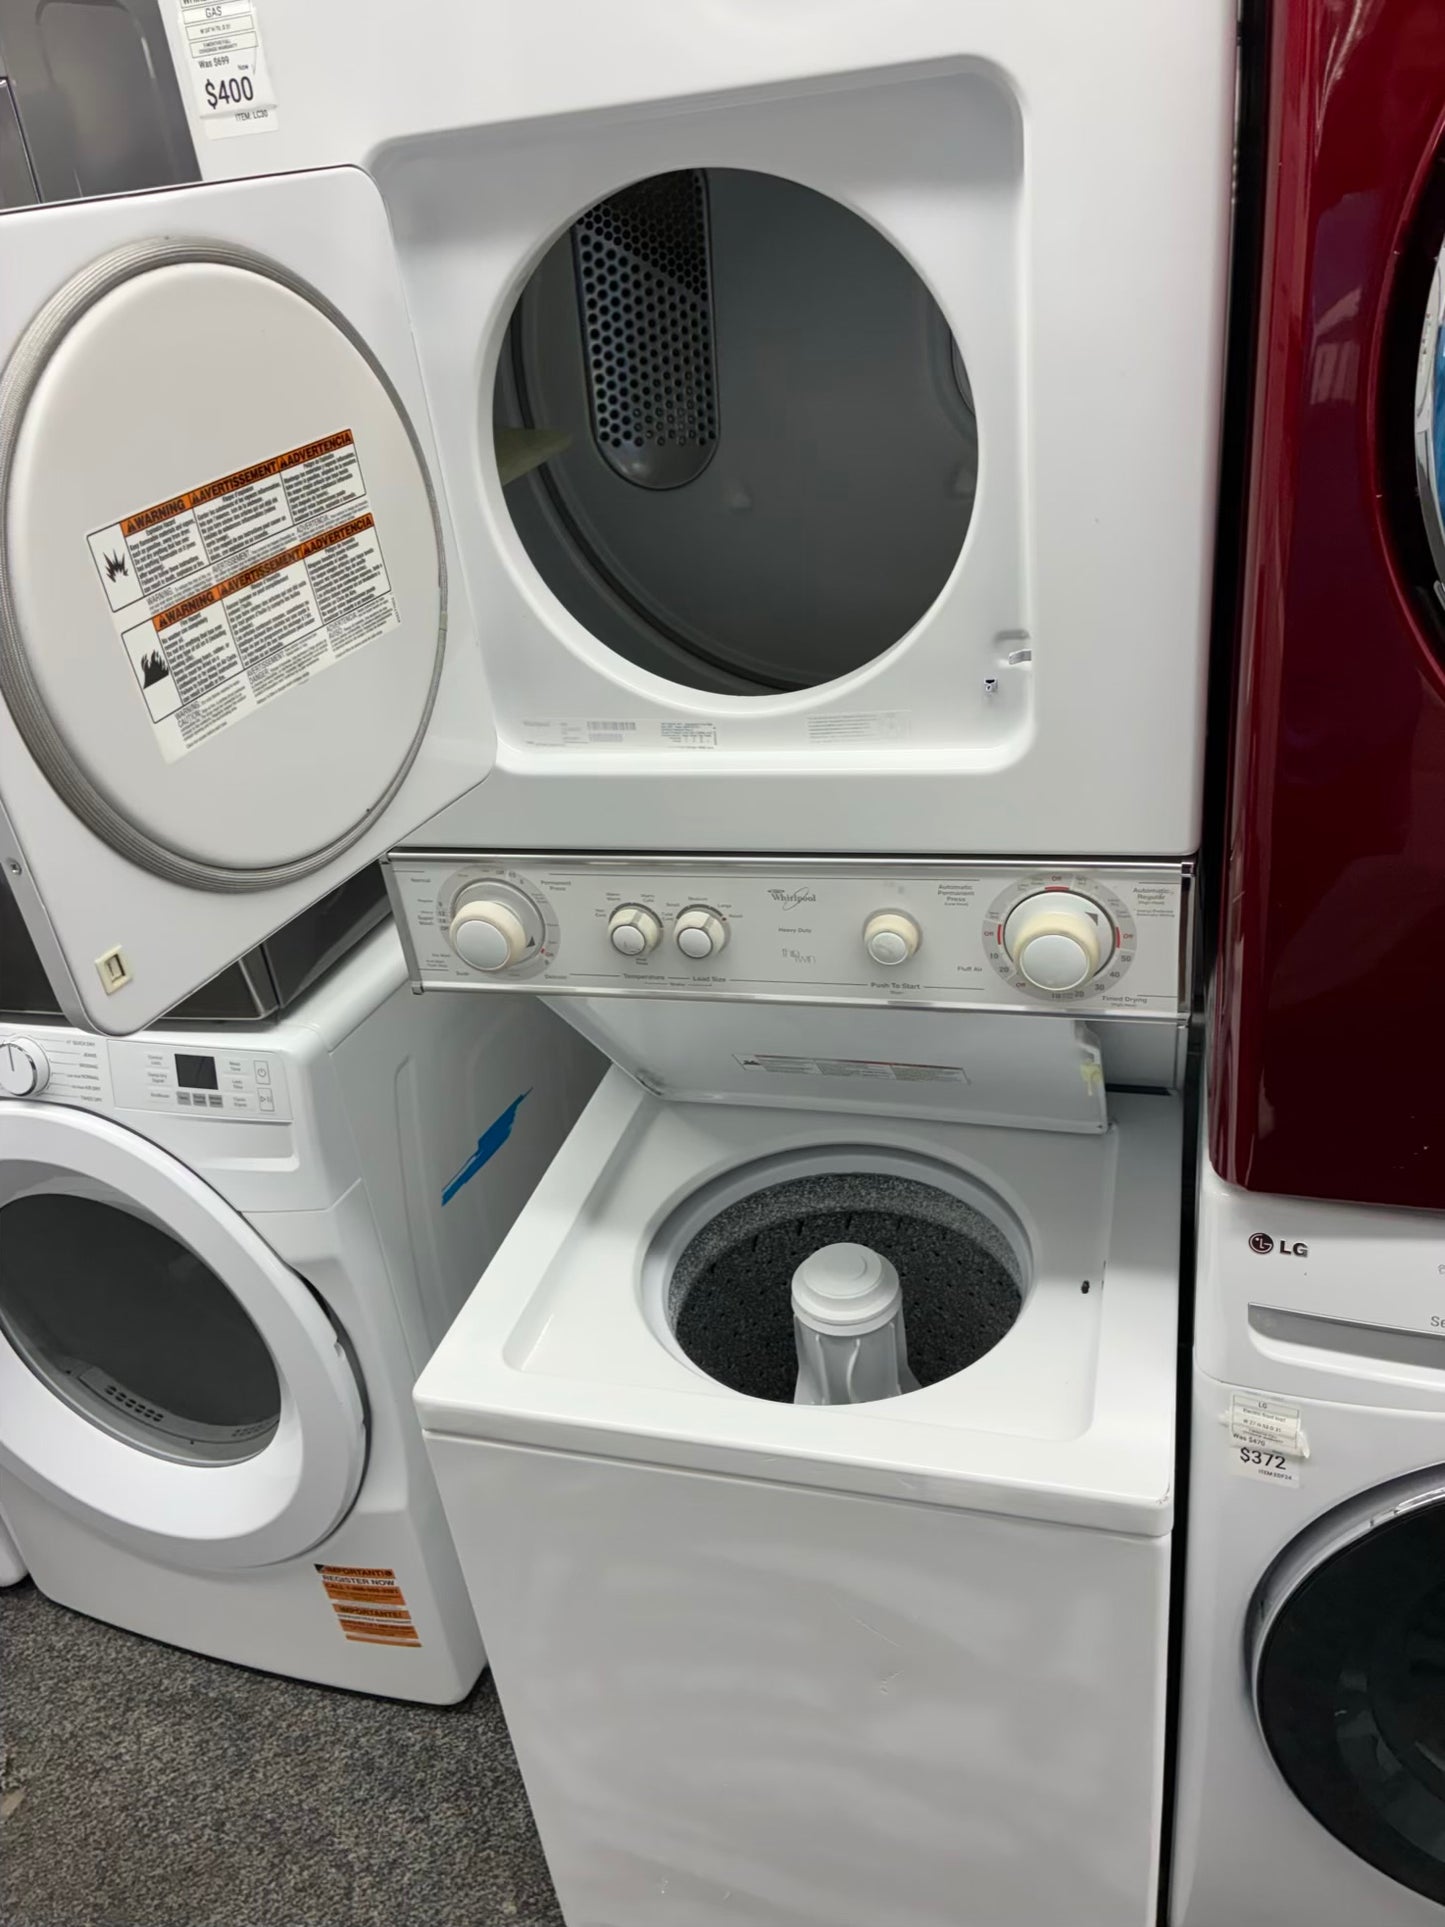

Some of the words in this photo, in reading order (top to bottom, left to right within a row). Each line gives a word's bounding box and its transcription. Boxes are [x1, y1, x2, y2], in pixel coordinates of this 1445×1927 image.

[205, 6, 222, 18] GAS
[198, 60, 213, 69] Was
[213, 56, 230, 67] $699
[205, 76, 254, 110] $400
[285, 430, 351, 466] ADVERTENCIA
[198, 460, 277, 501] AVERTISSEMENT
[133, 498, 186, 529] WARNING
[309, 514, 371, 553] ADVERTENCIA
[227, 547, 301, 592] AVERTISSEMENT
[164, 591, 214, 623] WARNING
[770, 891, 816, 905] Whirlpool
[1279, 1239, 1308, 1258] LG
[1233, 1433, 1247, 1442] Was
[1240, 1446, 1287, 1471] $372
[322, 1575, 369, 1585] REGISTER
